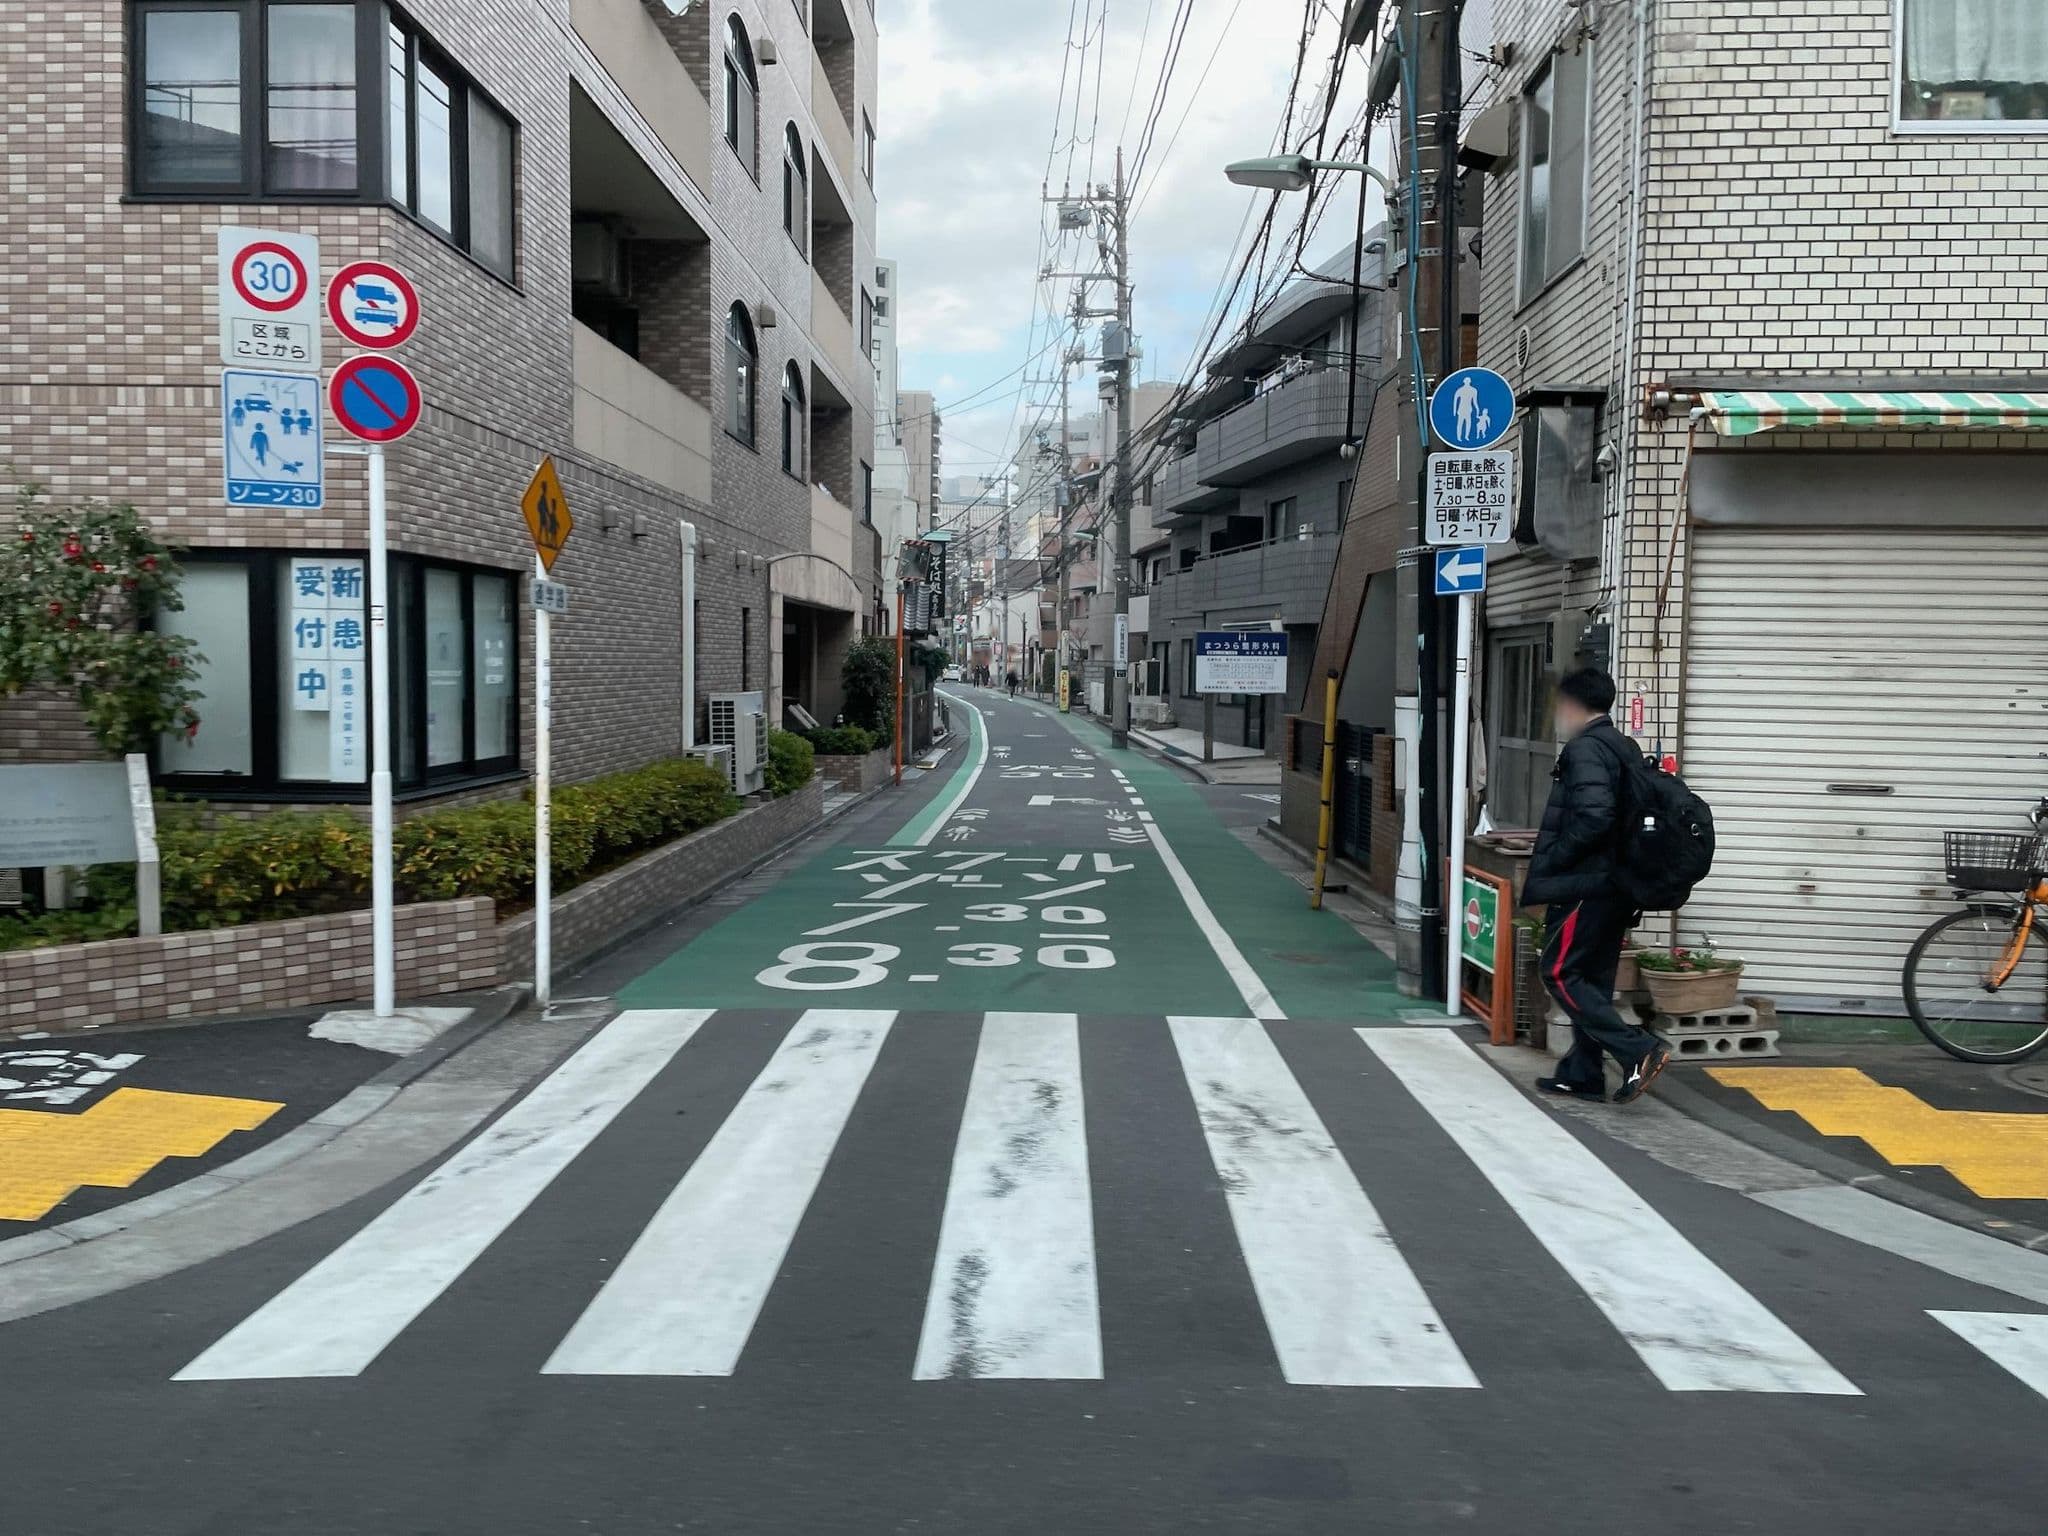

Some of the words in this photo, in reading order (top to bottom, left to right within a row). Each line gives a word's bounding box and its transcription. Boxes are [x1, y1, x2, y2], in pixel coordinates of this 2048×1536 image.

[250, 261, 291, 292] 30
[251, 323, 291, 340] 区域
[237, 340, 306, 359] ここから
[1435, 459, 1505, 473] 自転車を除く
[331, 566, 362, 649] 新患
[295, 566, 326, 699] 受付中
[831, 850, 1135, 873] スクール
[859, 872, 1107, 900] ゾーン
